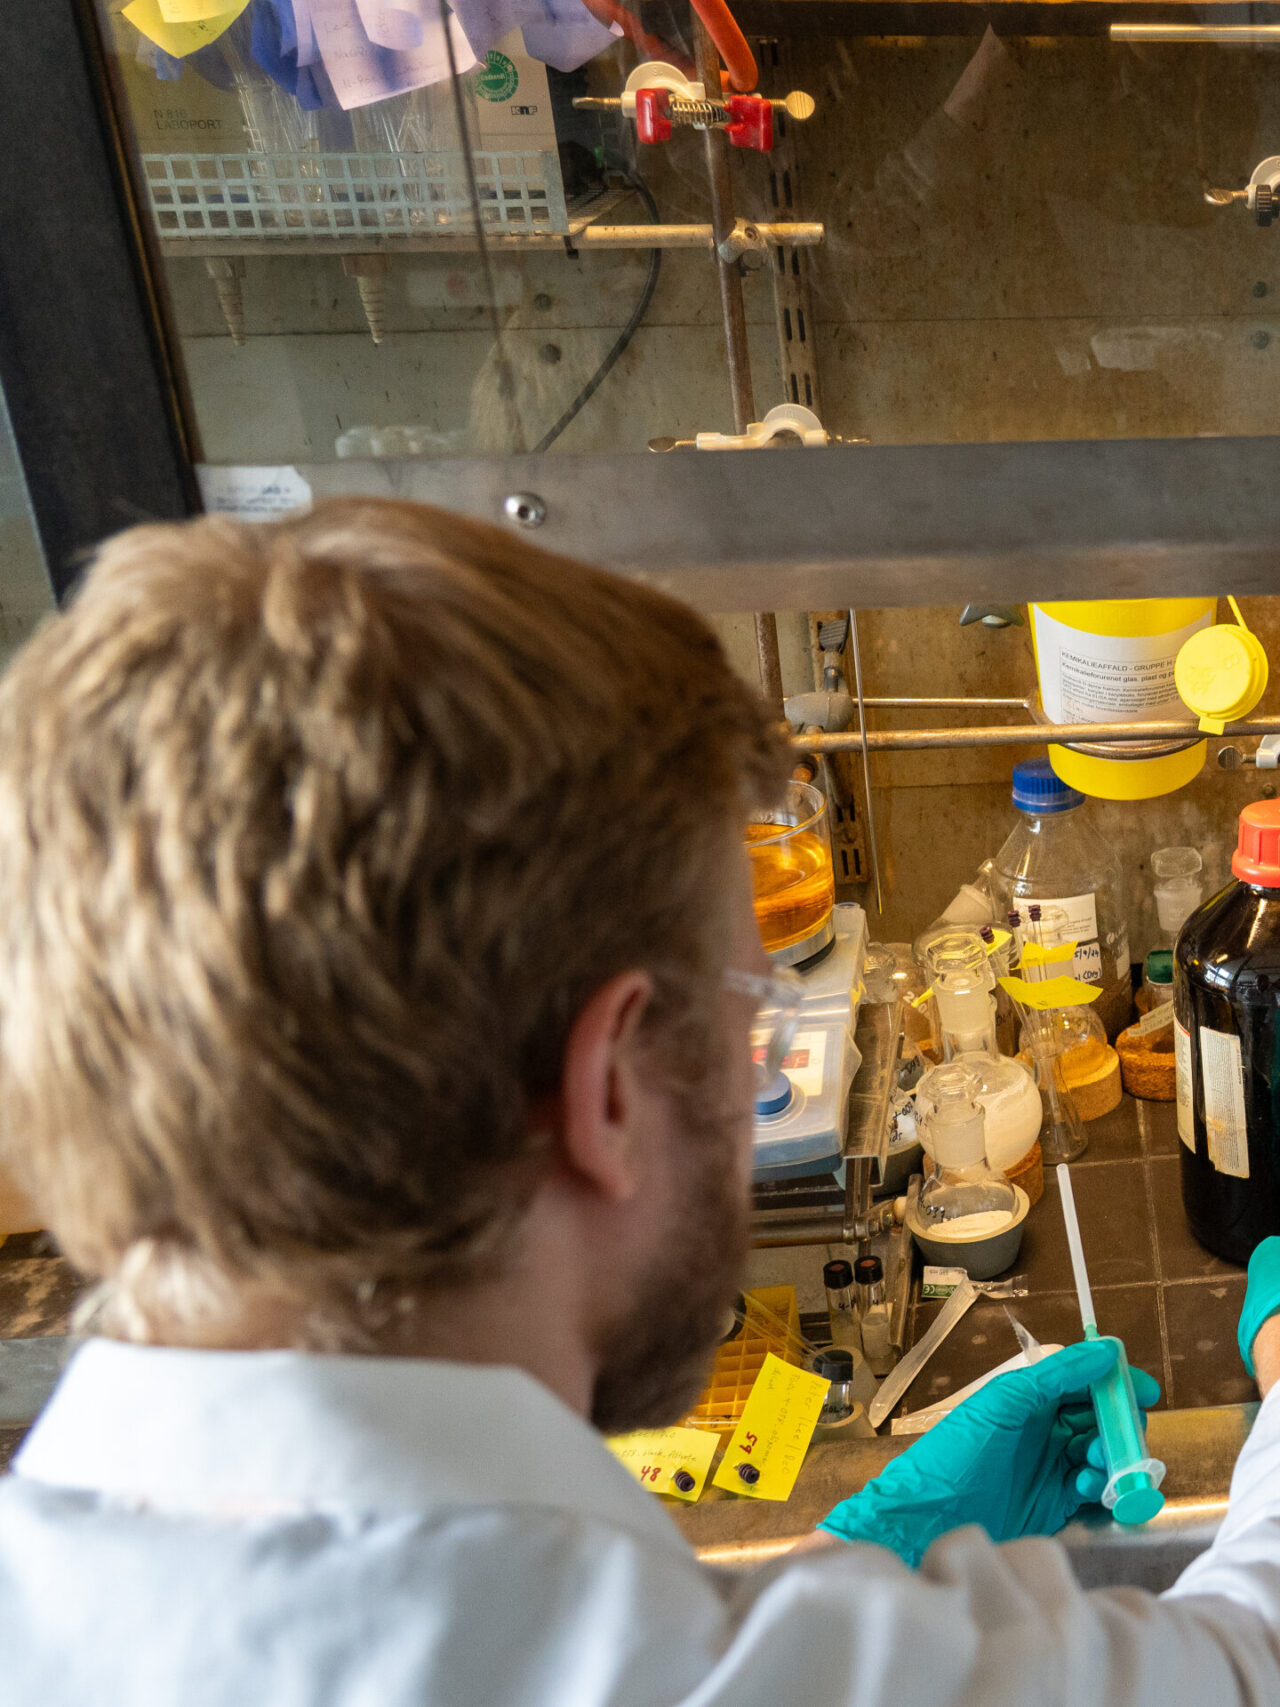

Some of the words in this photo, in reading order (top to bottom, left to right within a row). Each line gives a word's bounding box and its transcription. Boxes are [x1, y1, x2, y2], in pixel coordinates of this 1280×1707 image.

[156, 119, 222, 130] LABOPORT
[1133, 661, 1166, 672] GRUPPE
[640, 1465, 663, 1483] 48
